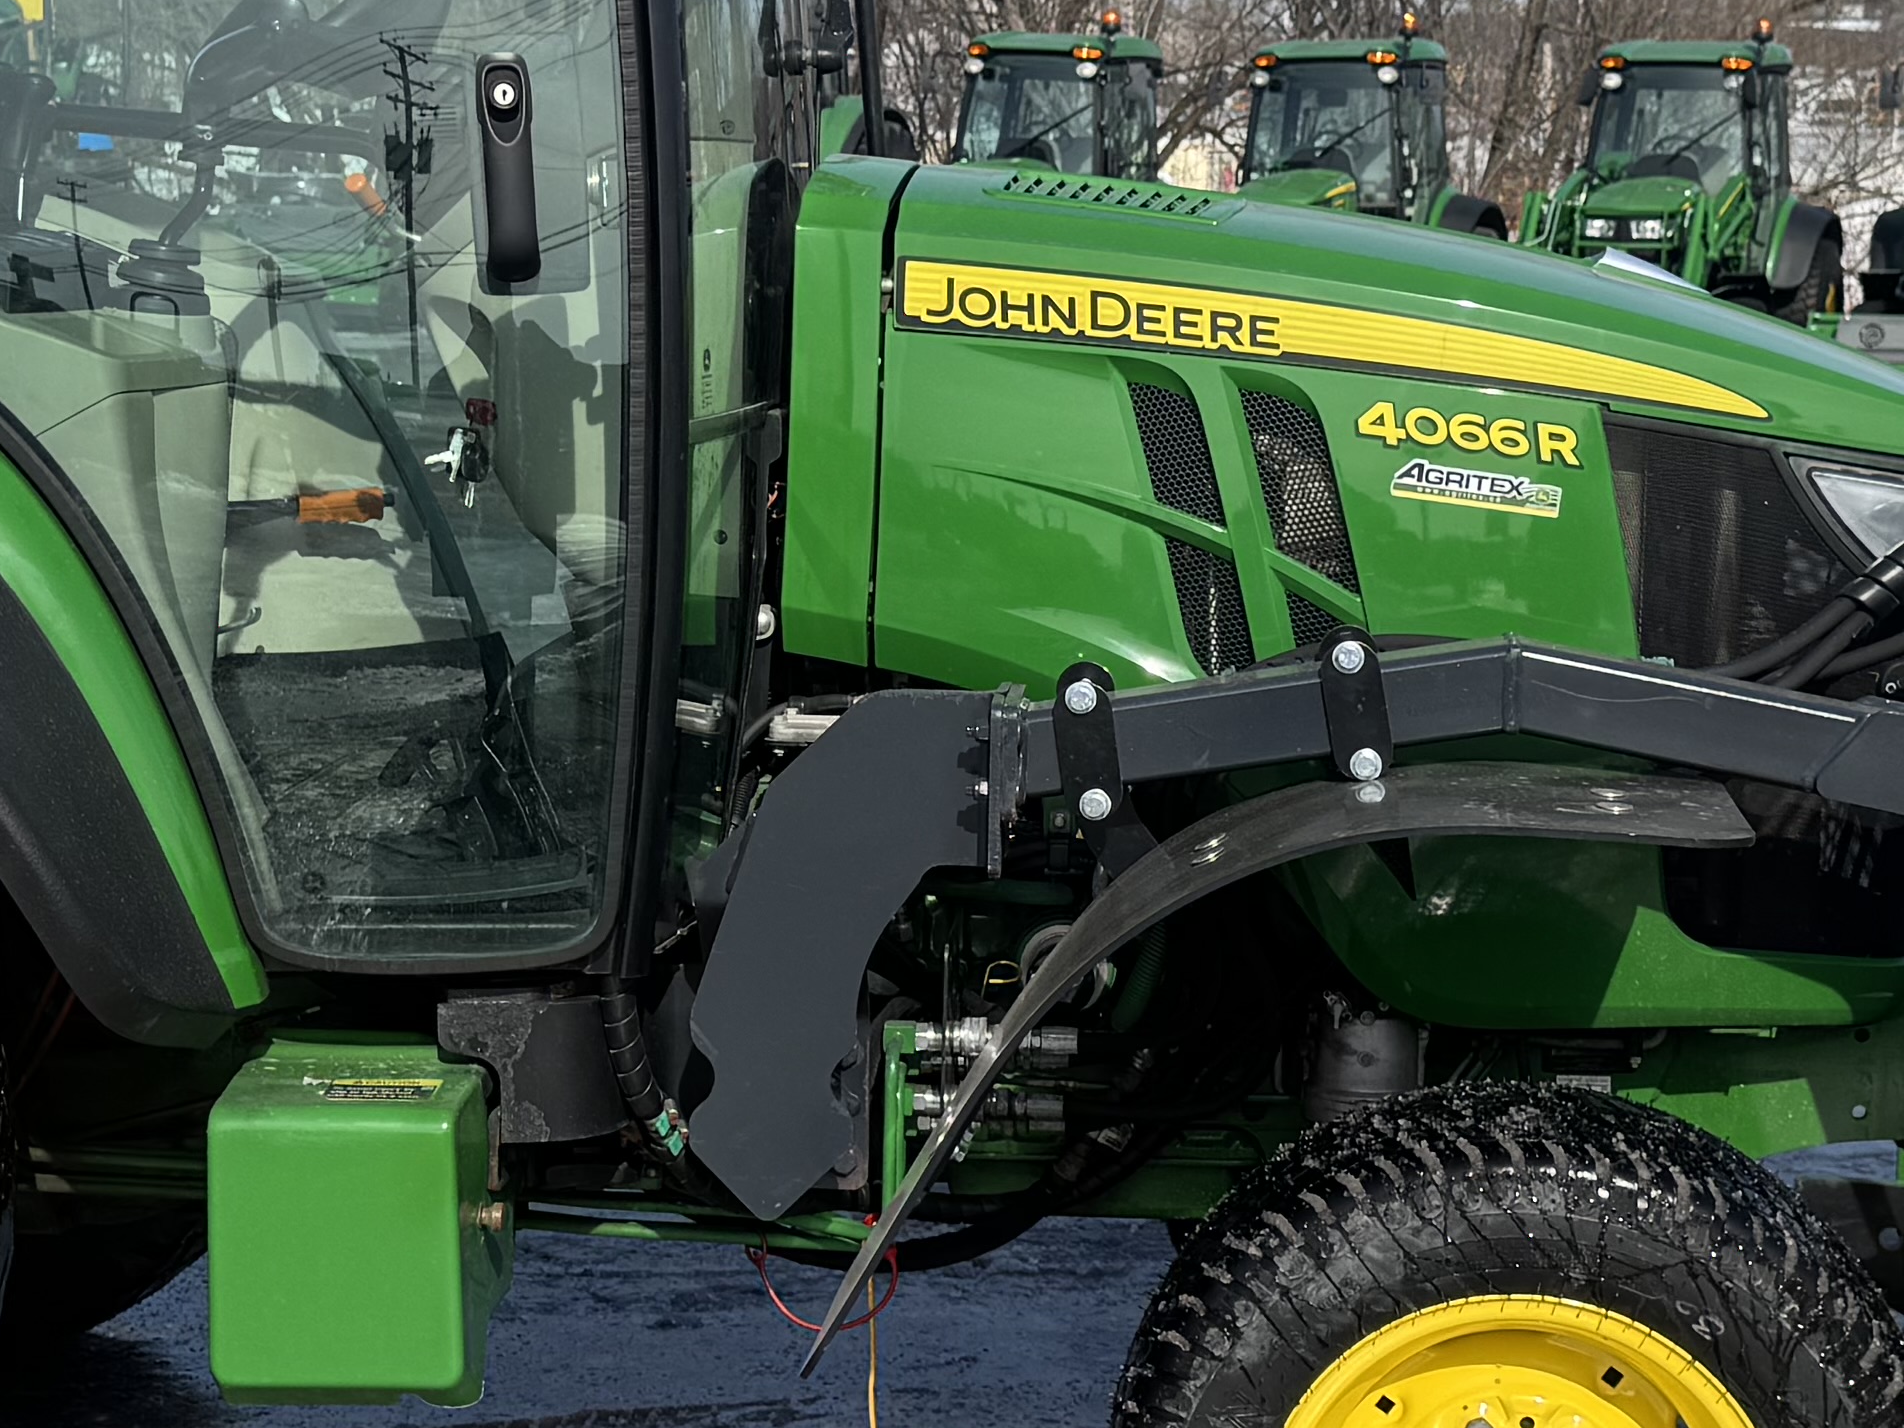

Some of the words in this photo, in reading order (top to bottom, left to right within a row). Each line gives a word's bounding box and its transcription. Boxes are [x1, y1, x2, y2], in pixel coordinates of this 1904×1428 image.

[925, 276, 1077, 330] JOHN
[1089, 289, 1282, 350] DEERE
[1395, 461, 1526, 498] AGRITEX
